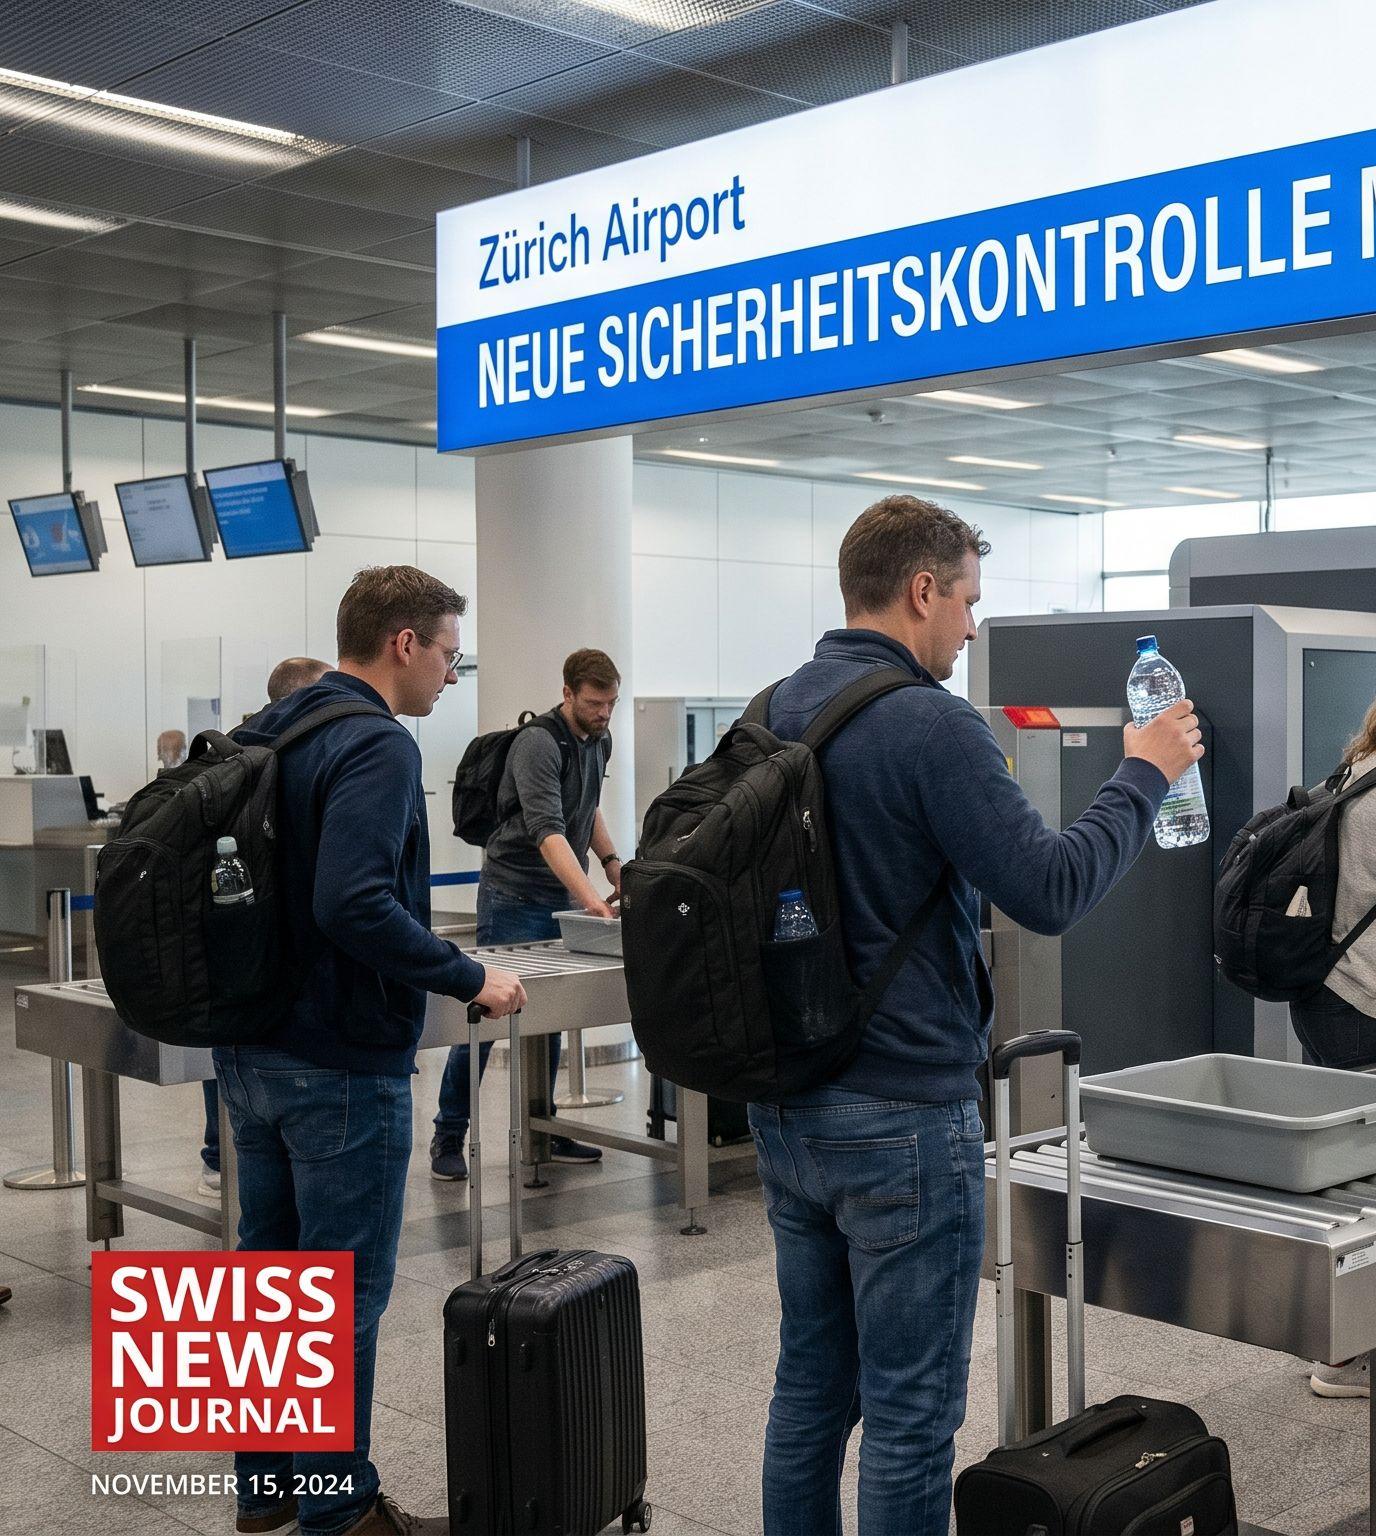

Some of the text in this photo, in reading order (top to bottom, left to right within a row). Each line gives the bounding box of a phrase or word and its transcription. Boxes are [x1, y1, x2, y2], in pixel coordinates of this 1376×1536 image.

[479, 323, 585, 408] NEUE
[598, 174, 1332, 388] SICHERHEITSKONTROLLE
[480, 176, 746, 289] Zürich Airport
